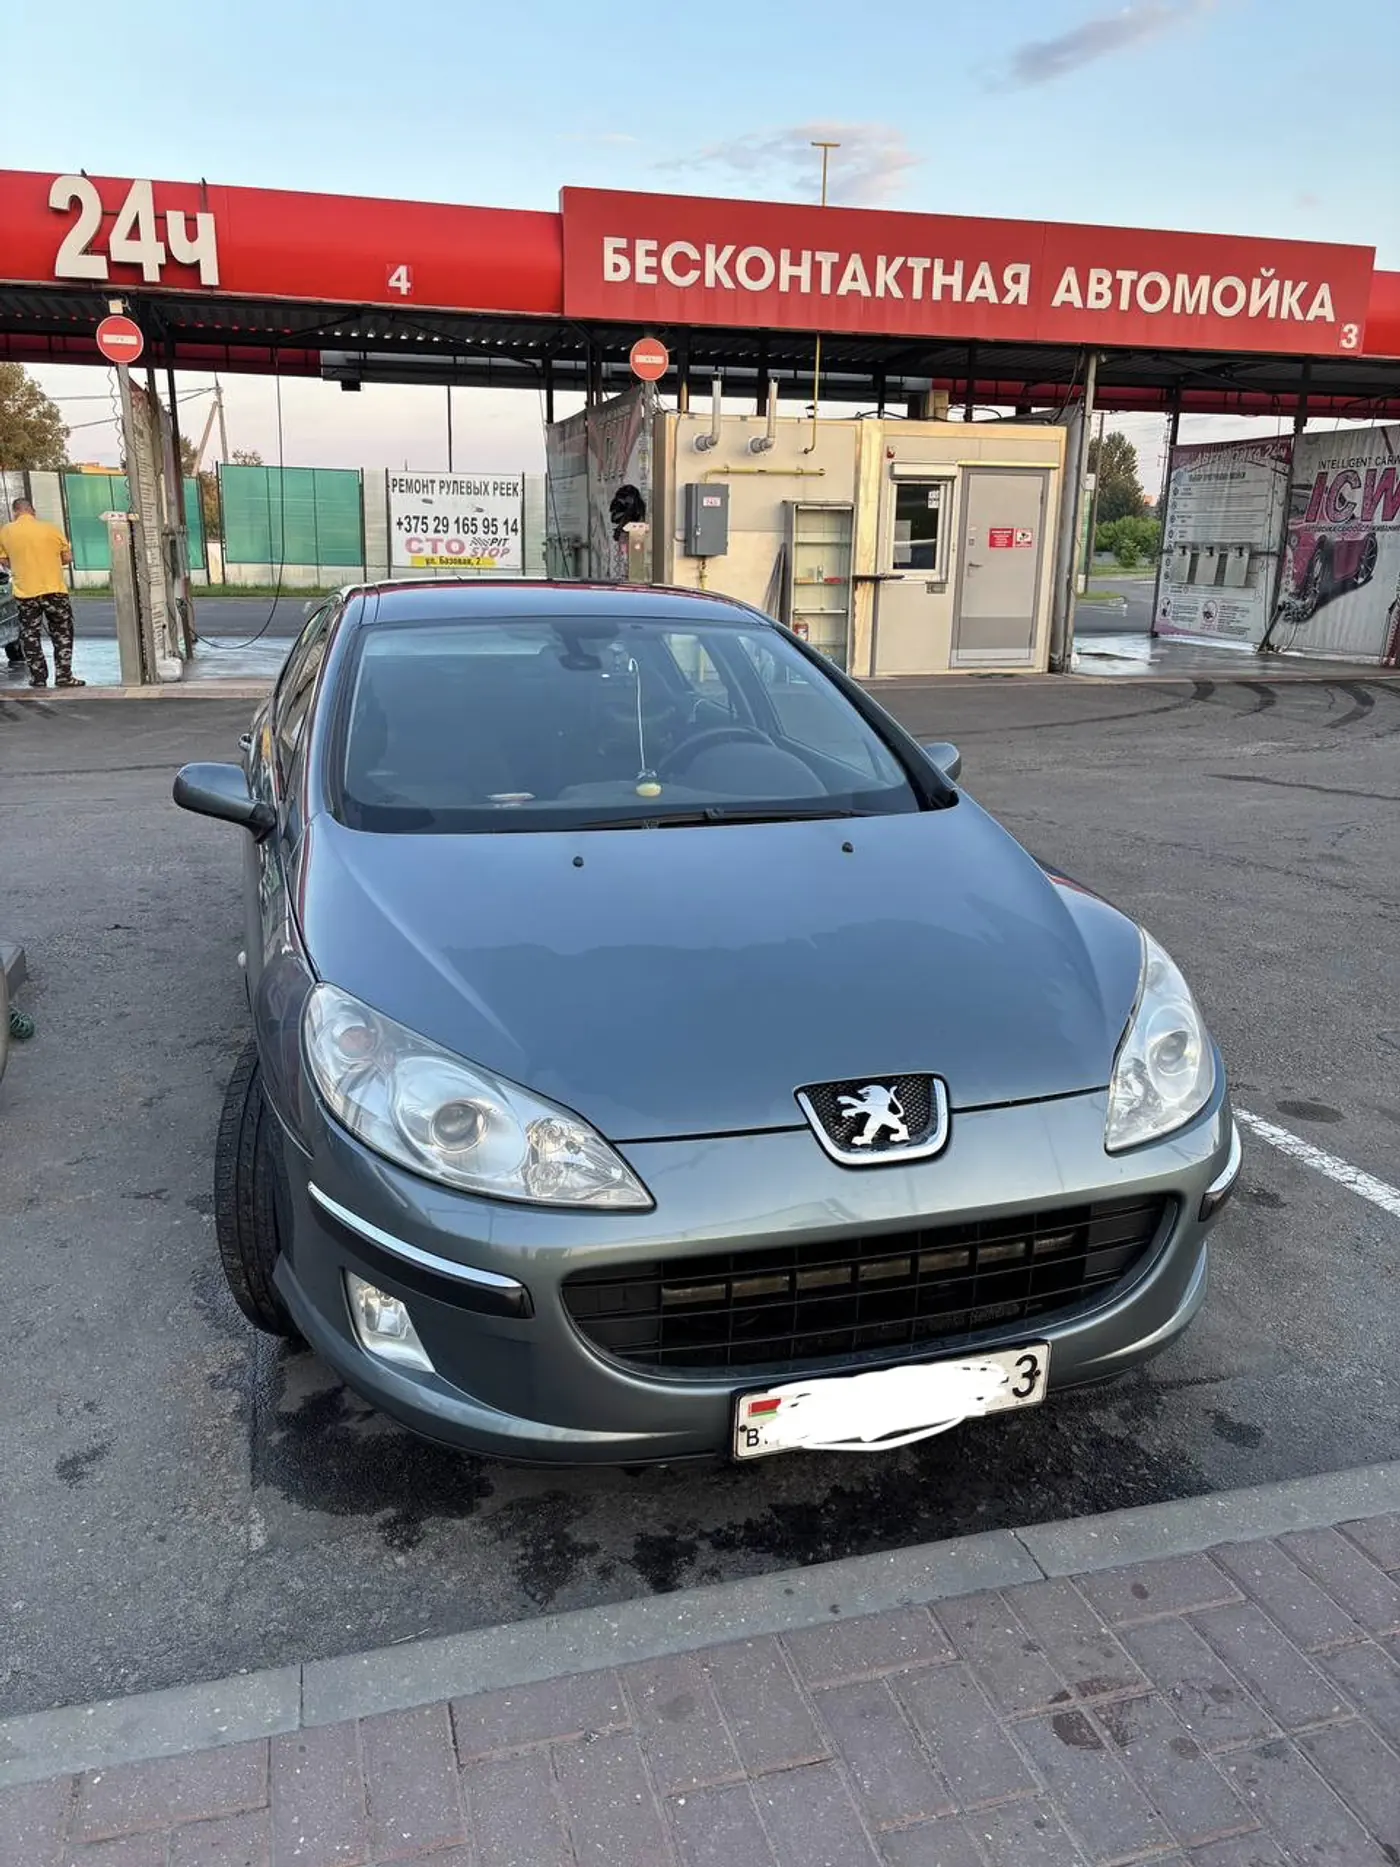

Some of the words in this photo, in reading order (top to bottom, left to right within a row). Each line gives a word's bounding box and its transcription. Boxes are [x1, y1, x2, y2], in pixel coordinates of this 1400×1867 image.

[49, 175, 220, 286] 24ч
[388, 264, 412, 296] 4
[603, 236, 1031, 306] БЕСКОНТАКТНАЯ
[1051, 267, 1336, 323] АВТОМОЙКА
[1341, 323, 1358, 349] 3
[391, 478, 436, 495] РЕМОНТ
[439, 480, 490, 496] РУЛЕВЫХ
[493, 481, 519, 497] РЕЕК
[396, 515, 429, 534] +375
[433, 516, 449, 534] 29
[454, 517, 478, 535] 165
[482, 518, 498, 535] 95
[503, 518, 519, 536] 14
[405, 537, 466, 555] СТО
[470, 547, 511, 558] STOP
[489, 538, 510, 547] PIT
[1012, 1354, 1040, 1399] 3
